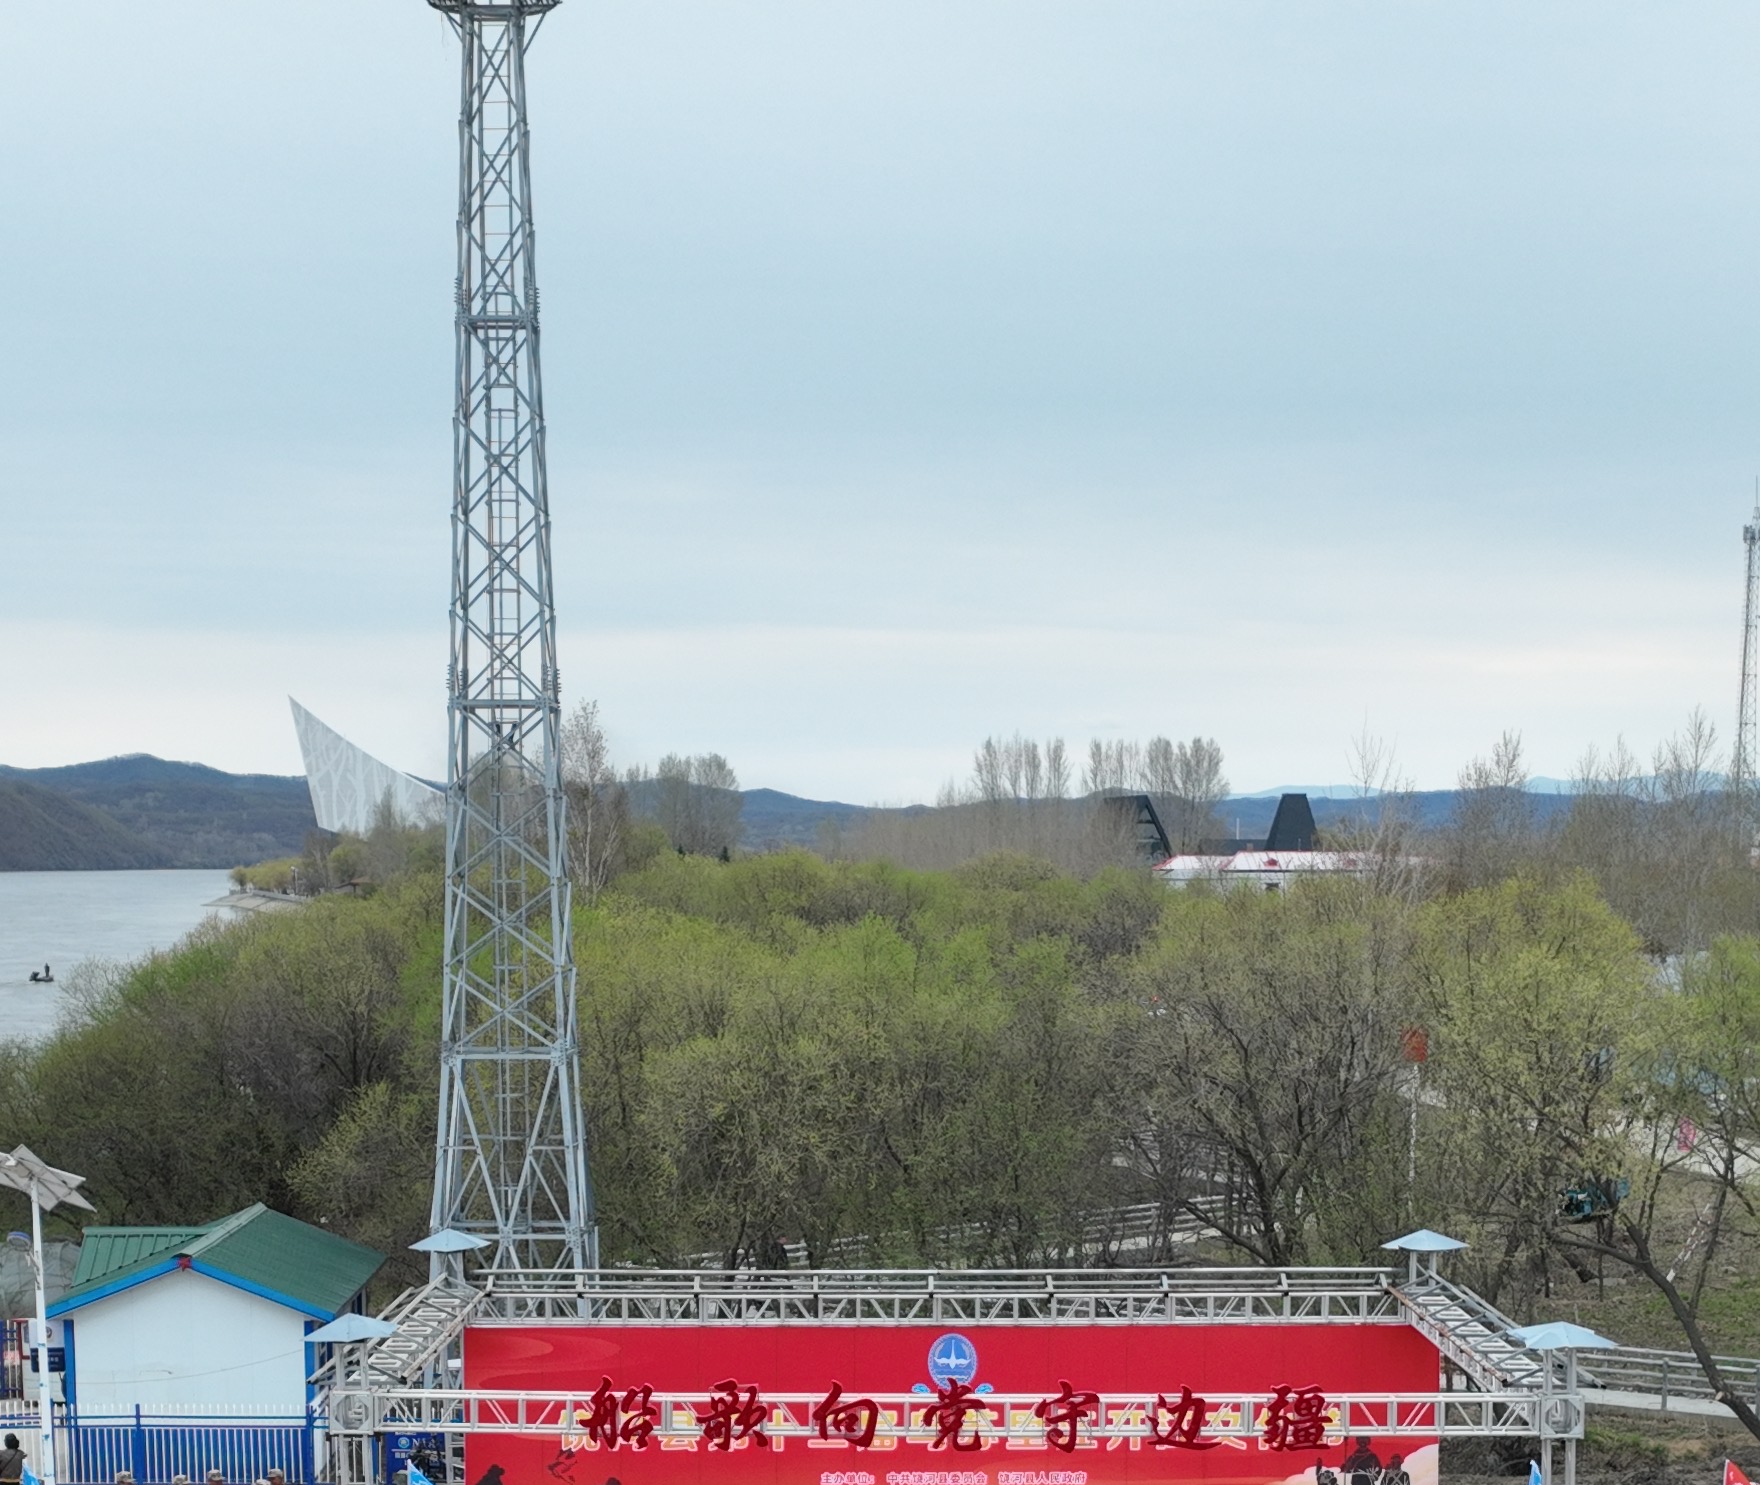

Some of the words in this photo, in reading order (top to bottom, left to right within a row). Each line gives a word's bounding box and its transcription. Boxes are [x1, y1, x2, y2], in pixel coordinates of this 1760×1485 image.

[578, 1374, 1334, 1453] 船歌向党守边疆
[886, 1471, 988, 1485] 中共饶河县委员会
[998, 1471, 1087, 1485] 饶河县人民政府
